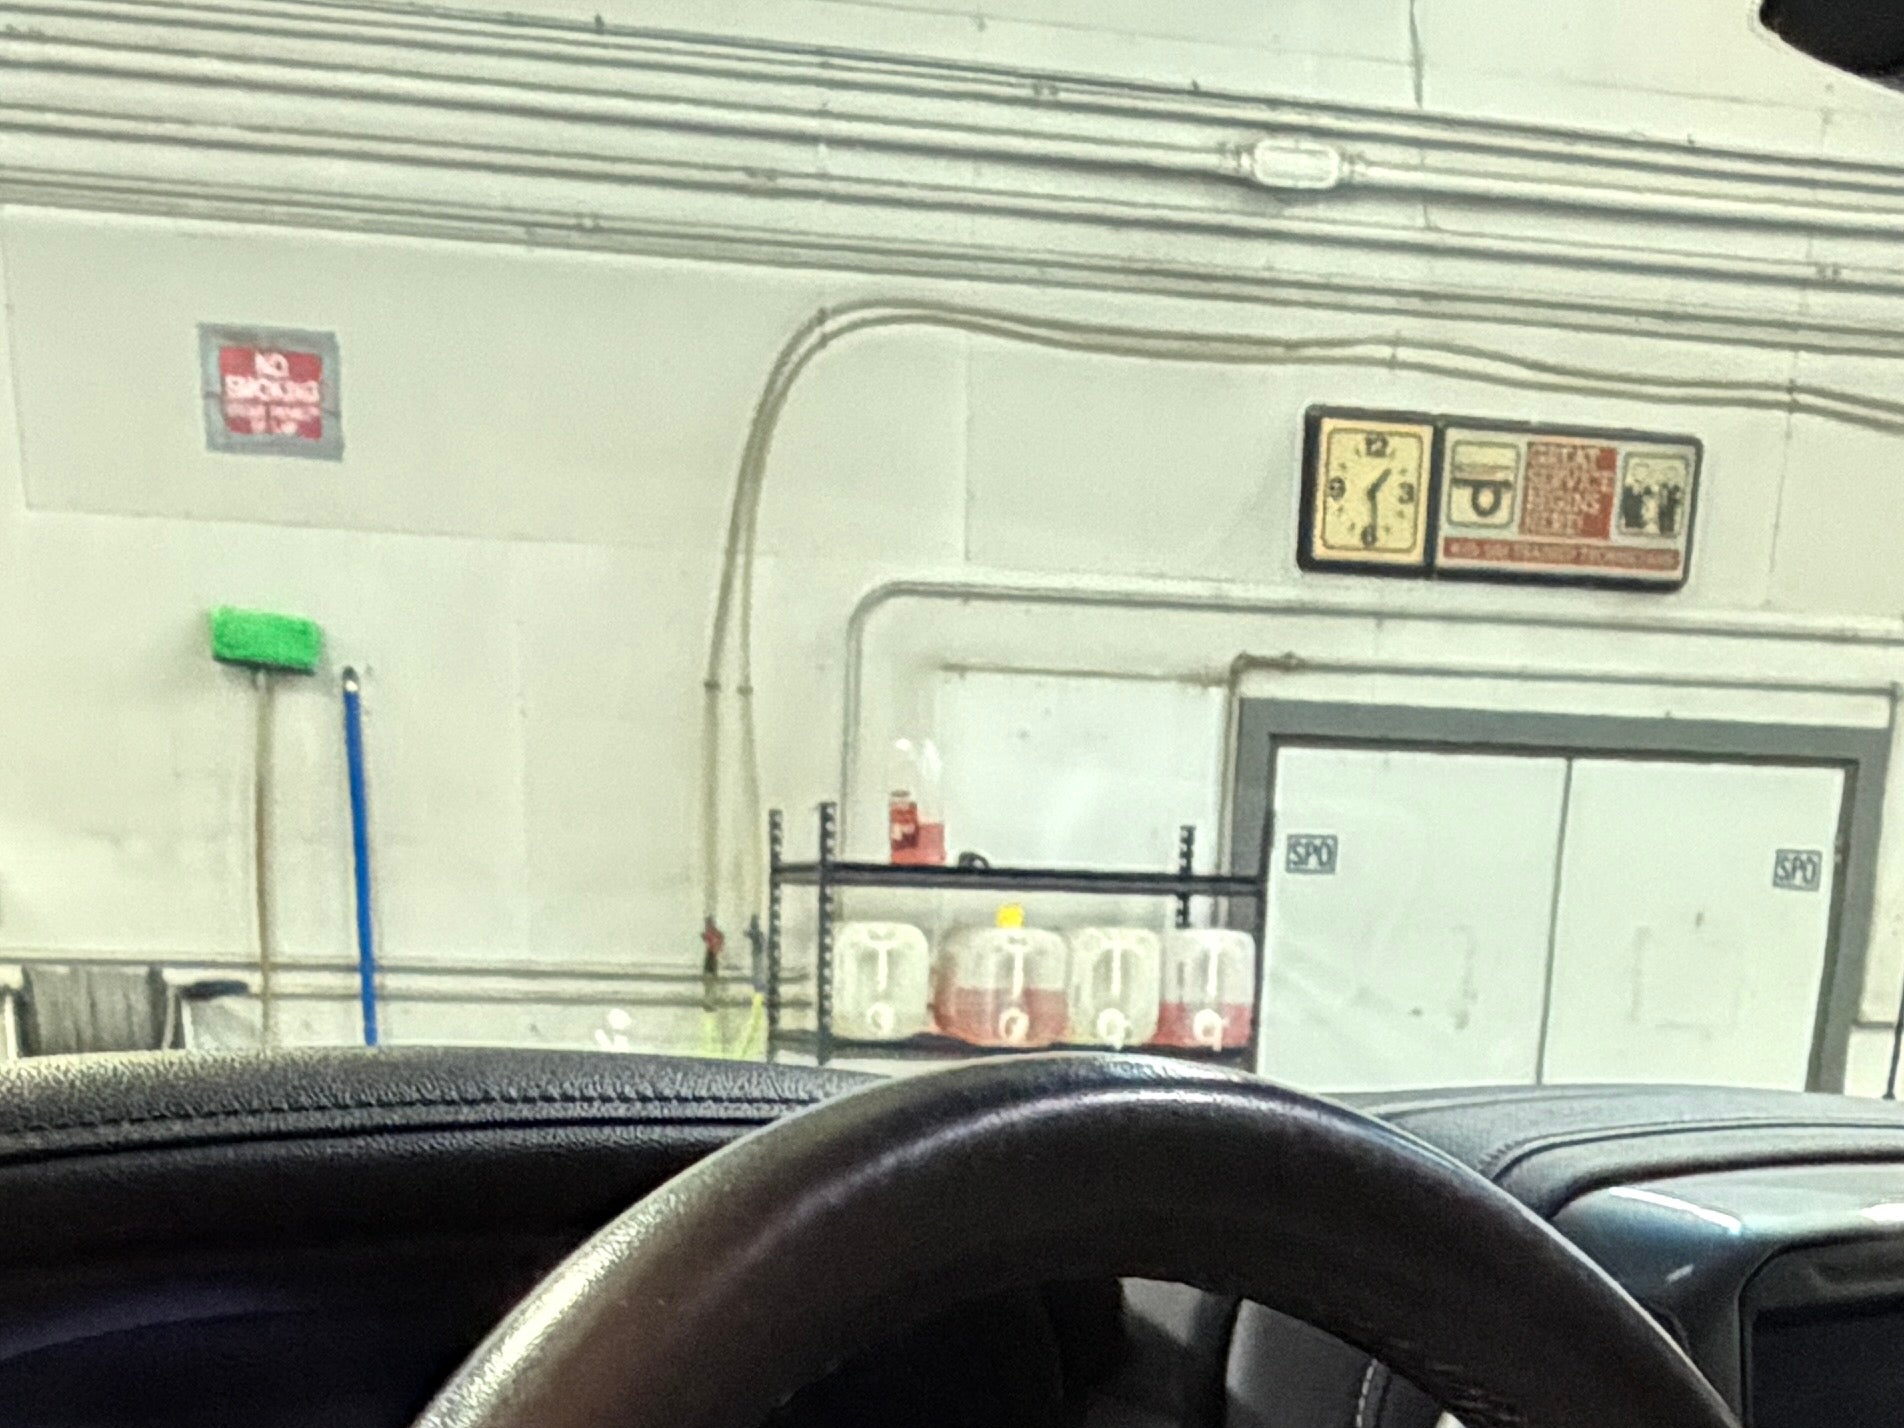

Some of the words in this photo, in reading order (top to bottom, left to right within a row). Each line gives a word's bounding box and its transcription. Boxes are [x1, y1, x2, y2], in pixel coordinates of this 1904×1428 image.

[254, 351, 290, 378] NO
[1364, 430, 1389, 458] 12
[1327, 476, 1346, 501] 9
[1398, 481, 1415, 505] 3
